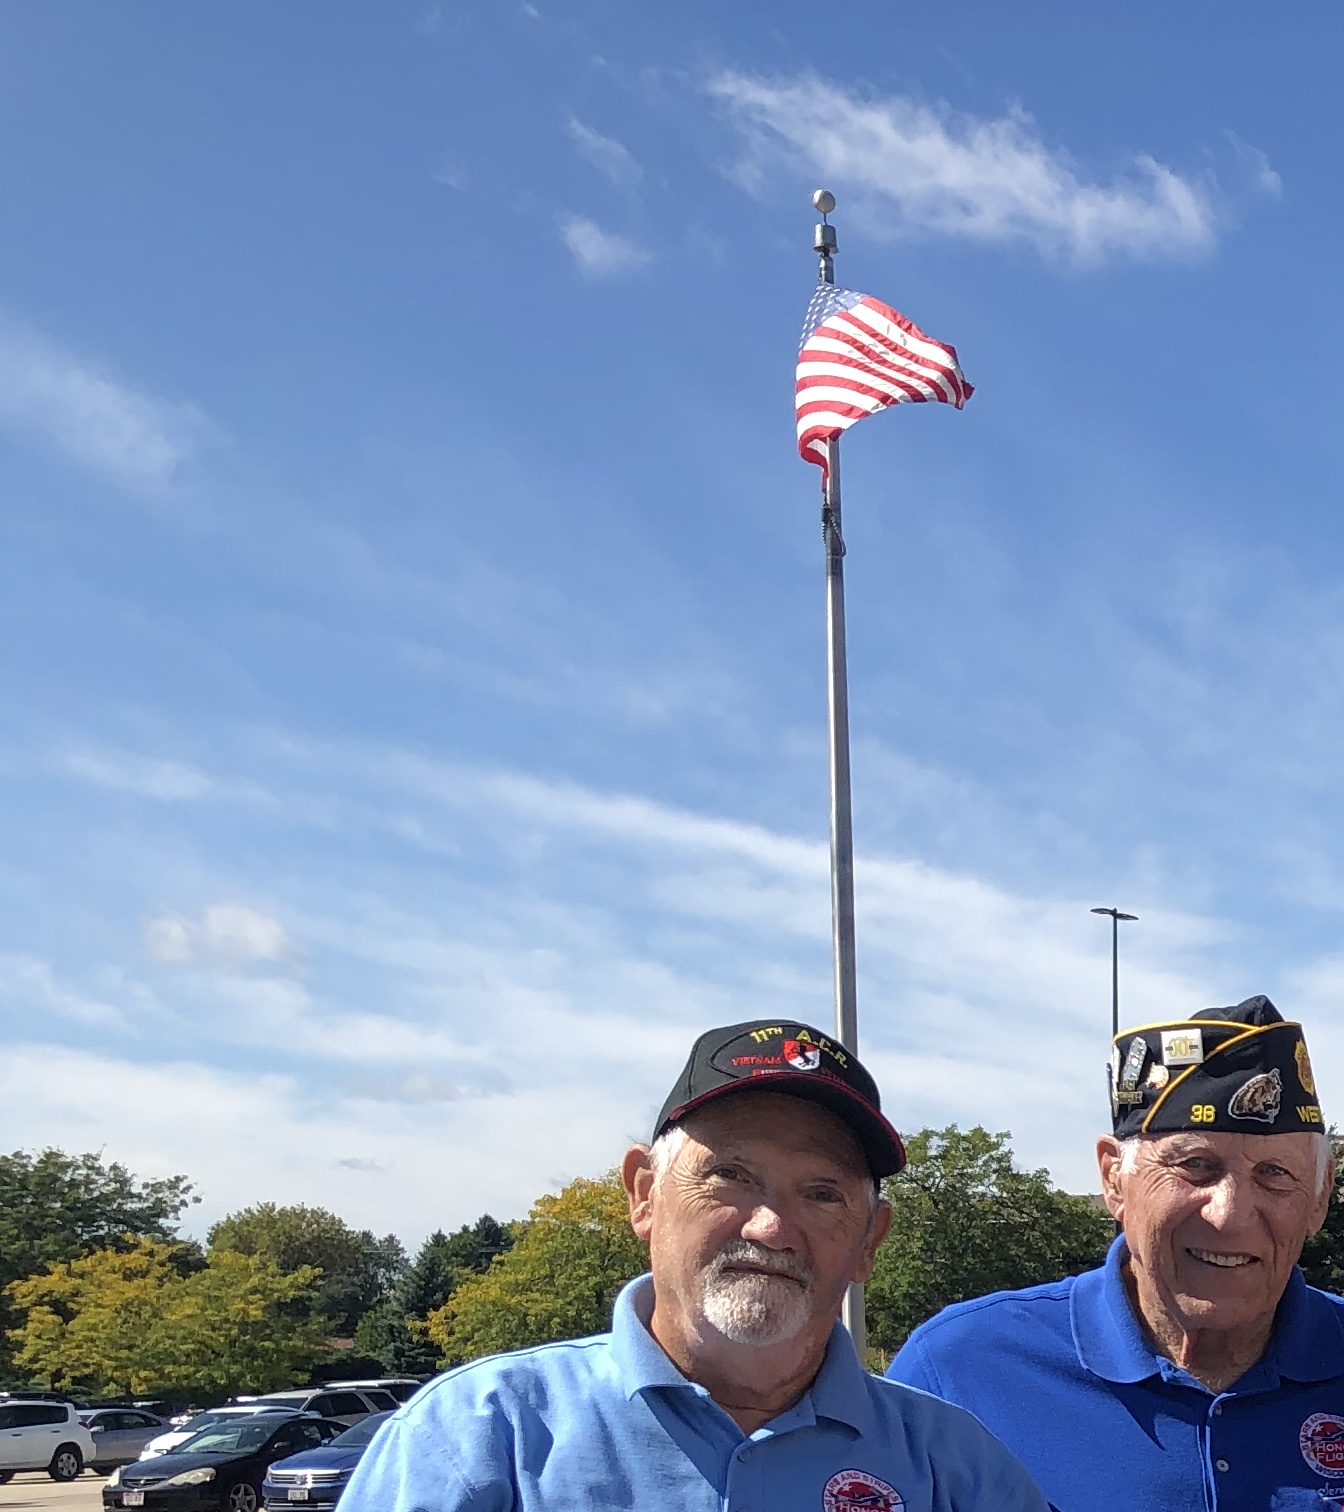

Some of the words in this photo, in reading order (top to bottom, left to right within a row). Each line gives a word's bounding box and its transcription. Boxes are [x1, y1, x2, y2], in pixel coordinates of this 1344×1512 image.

[750, 1027, 783, 1044] 11TH
[732, 1055, 782, 1066] VIETNAM
[1296, 1105, 1323, 1123] WE
